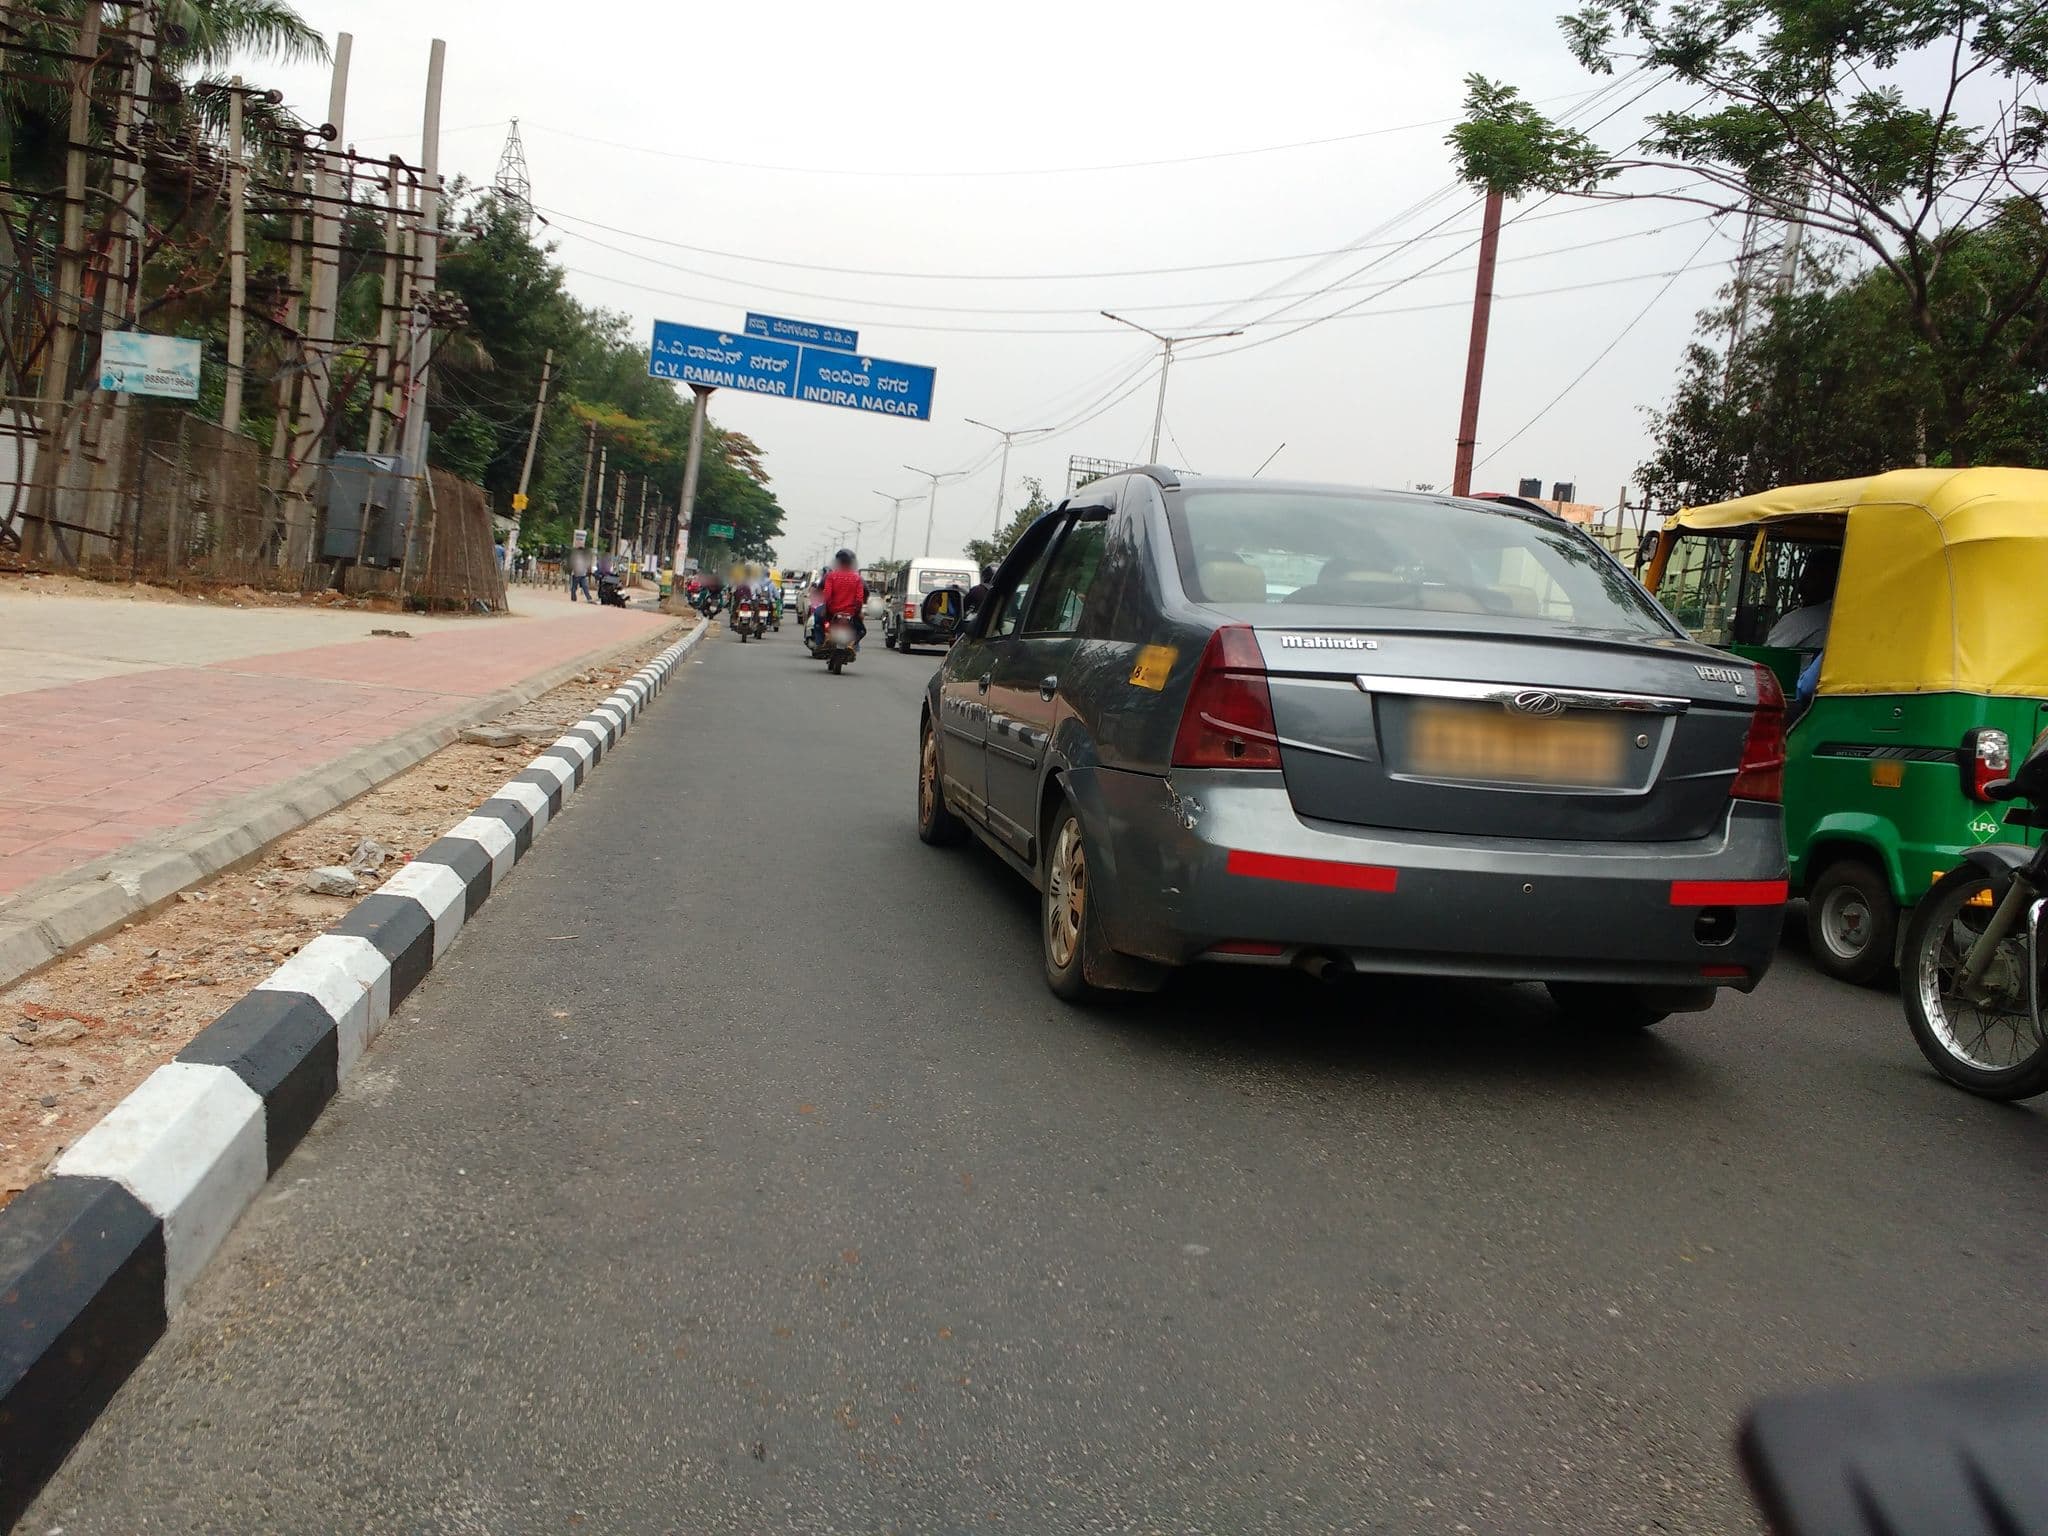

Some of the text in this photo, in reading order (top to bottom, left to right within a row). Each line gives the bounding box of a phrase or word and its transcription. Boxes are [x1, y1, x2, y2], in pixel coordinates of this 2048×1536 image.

[749, 355, 790, 372] ನಗರ್
[654, 361, 787, 395] C.V. RAMAN NAGAR
[819, 367, 910, 393] ಇಂದಿರಾ ನಗರ
[804, 385, 918, 416] INDIRA NAGAR
[1281, 635, 1378, 650] Mahindra
[1693, 665, 1742, 684] VERITO
[1973, 821, 1996, 833] LPG
